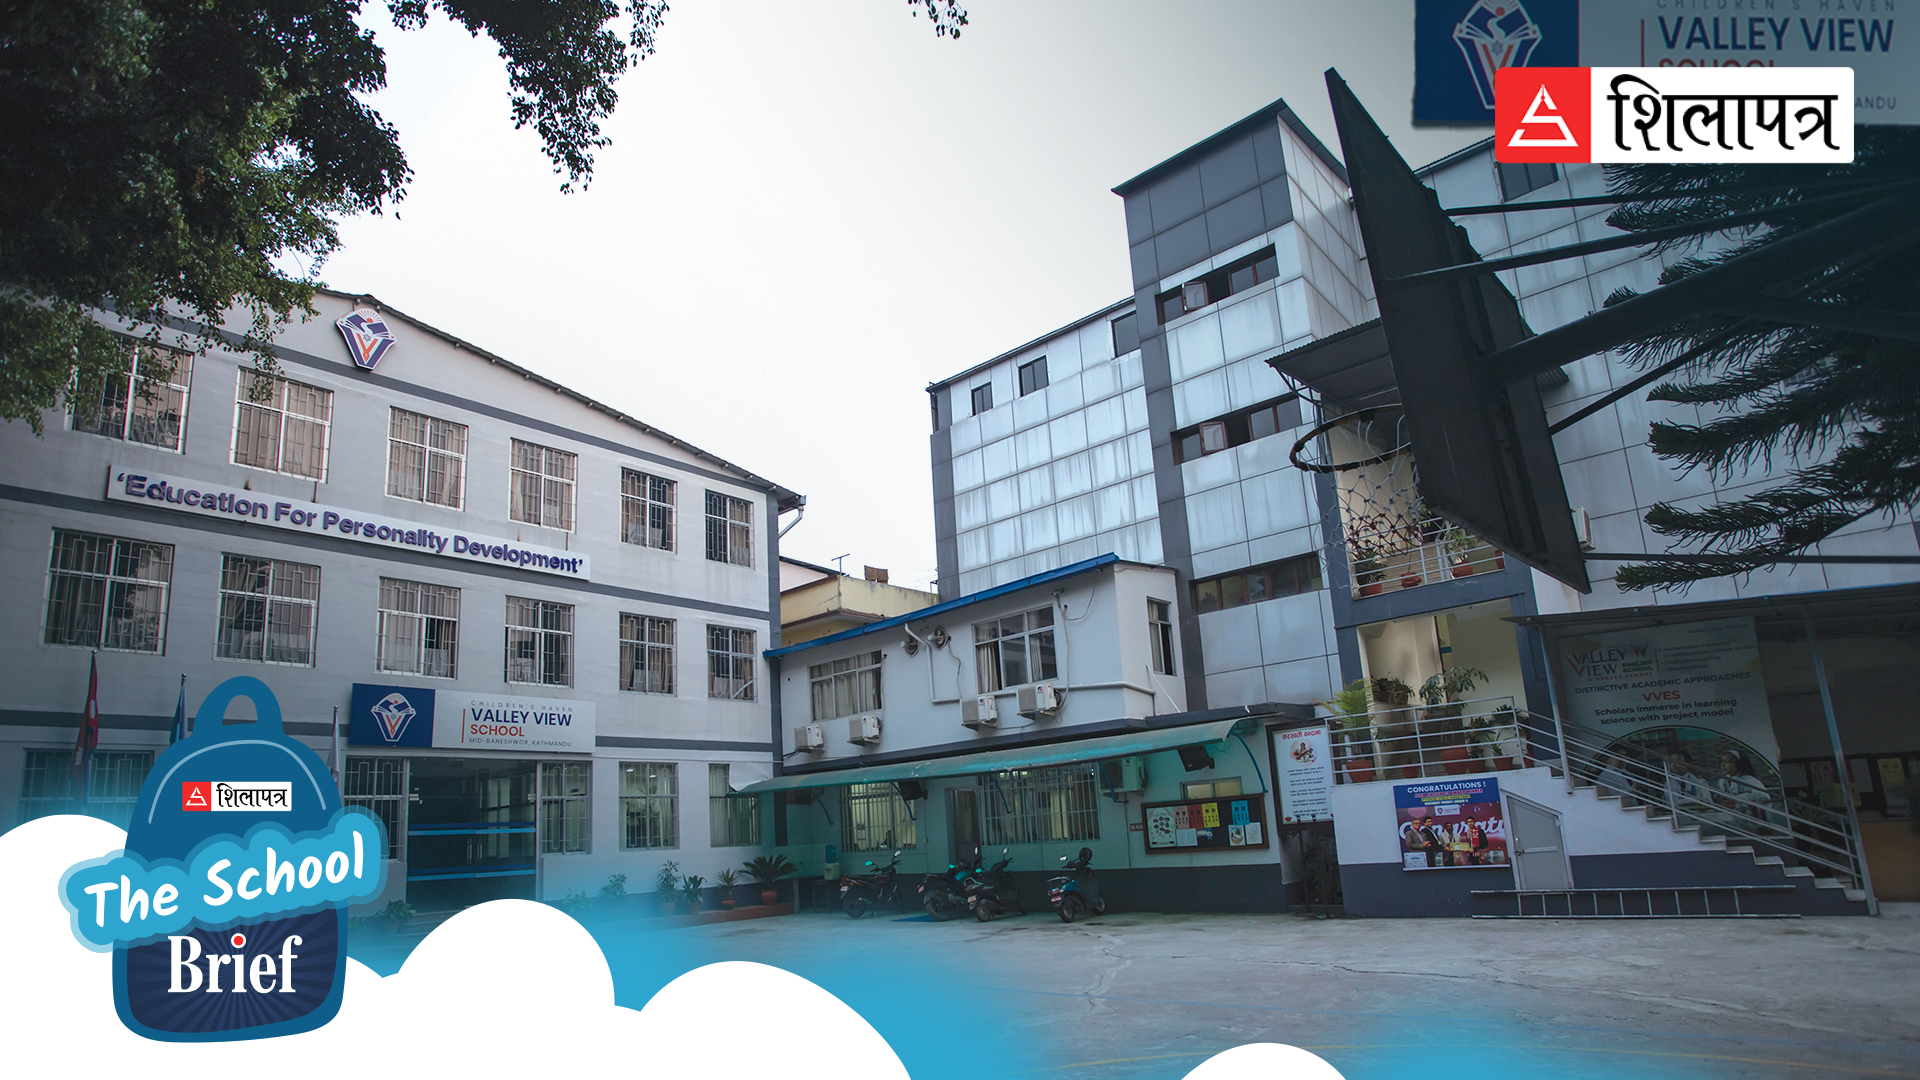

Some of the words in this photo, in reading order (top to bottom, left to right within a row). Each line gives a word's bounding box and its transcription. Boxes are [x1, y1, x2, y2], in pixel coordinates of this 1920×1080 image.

[1657, 16, 1791, 51] VALLEY
[1800, 18, 1895, 52] VIEW
[274, 501, 317, 527] For
[323, 511, 449, 554] Personality
[1572, 648, 1627, 664] VALLEY
[1622, 660, 1653, 668] ENGLISH
[1565, 655, 1618, 677] VIEW
[1622, 666, 1653, 674] SCHOOL
[1575, 683, 1629, 694] DISTINCTIVE
[1631, 678, 1681, 689] ACADEMIC
[1683, 671, 1752, 684] APPROACHES
[1642, 690, 1681, 702] VVES
[471, 700, 534, 710] CHILDREN'S
[541, 705, 573, 713] HAVEN
[1594, 706, 1635, 716] Scholars
[1636, 702, 1680, 713] immerse
[1682, 701, 1692, 709] in
[1694, 697, 1737, 709] learning
[471, 708, 530, 724] VALLEY
[534, 712, 572, 726] VIEW
[1600, 715, 1636, 724] science
[1638, 713, 1660, 722] with
[1663, 711, 1698, 723] project
[1700, 707, 1734, 717] model
[470, 724, 525, 737] SCHOOL
[1407, 782, 1481, 793] CONGRATULATIONS
